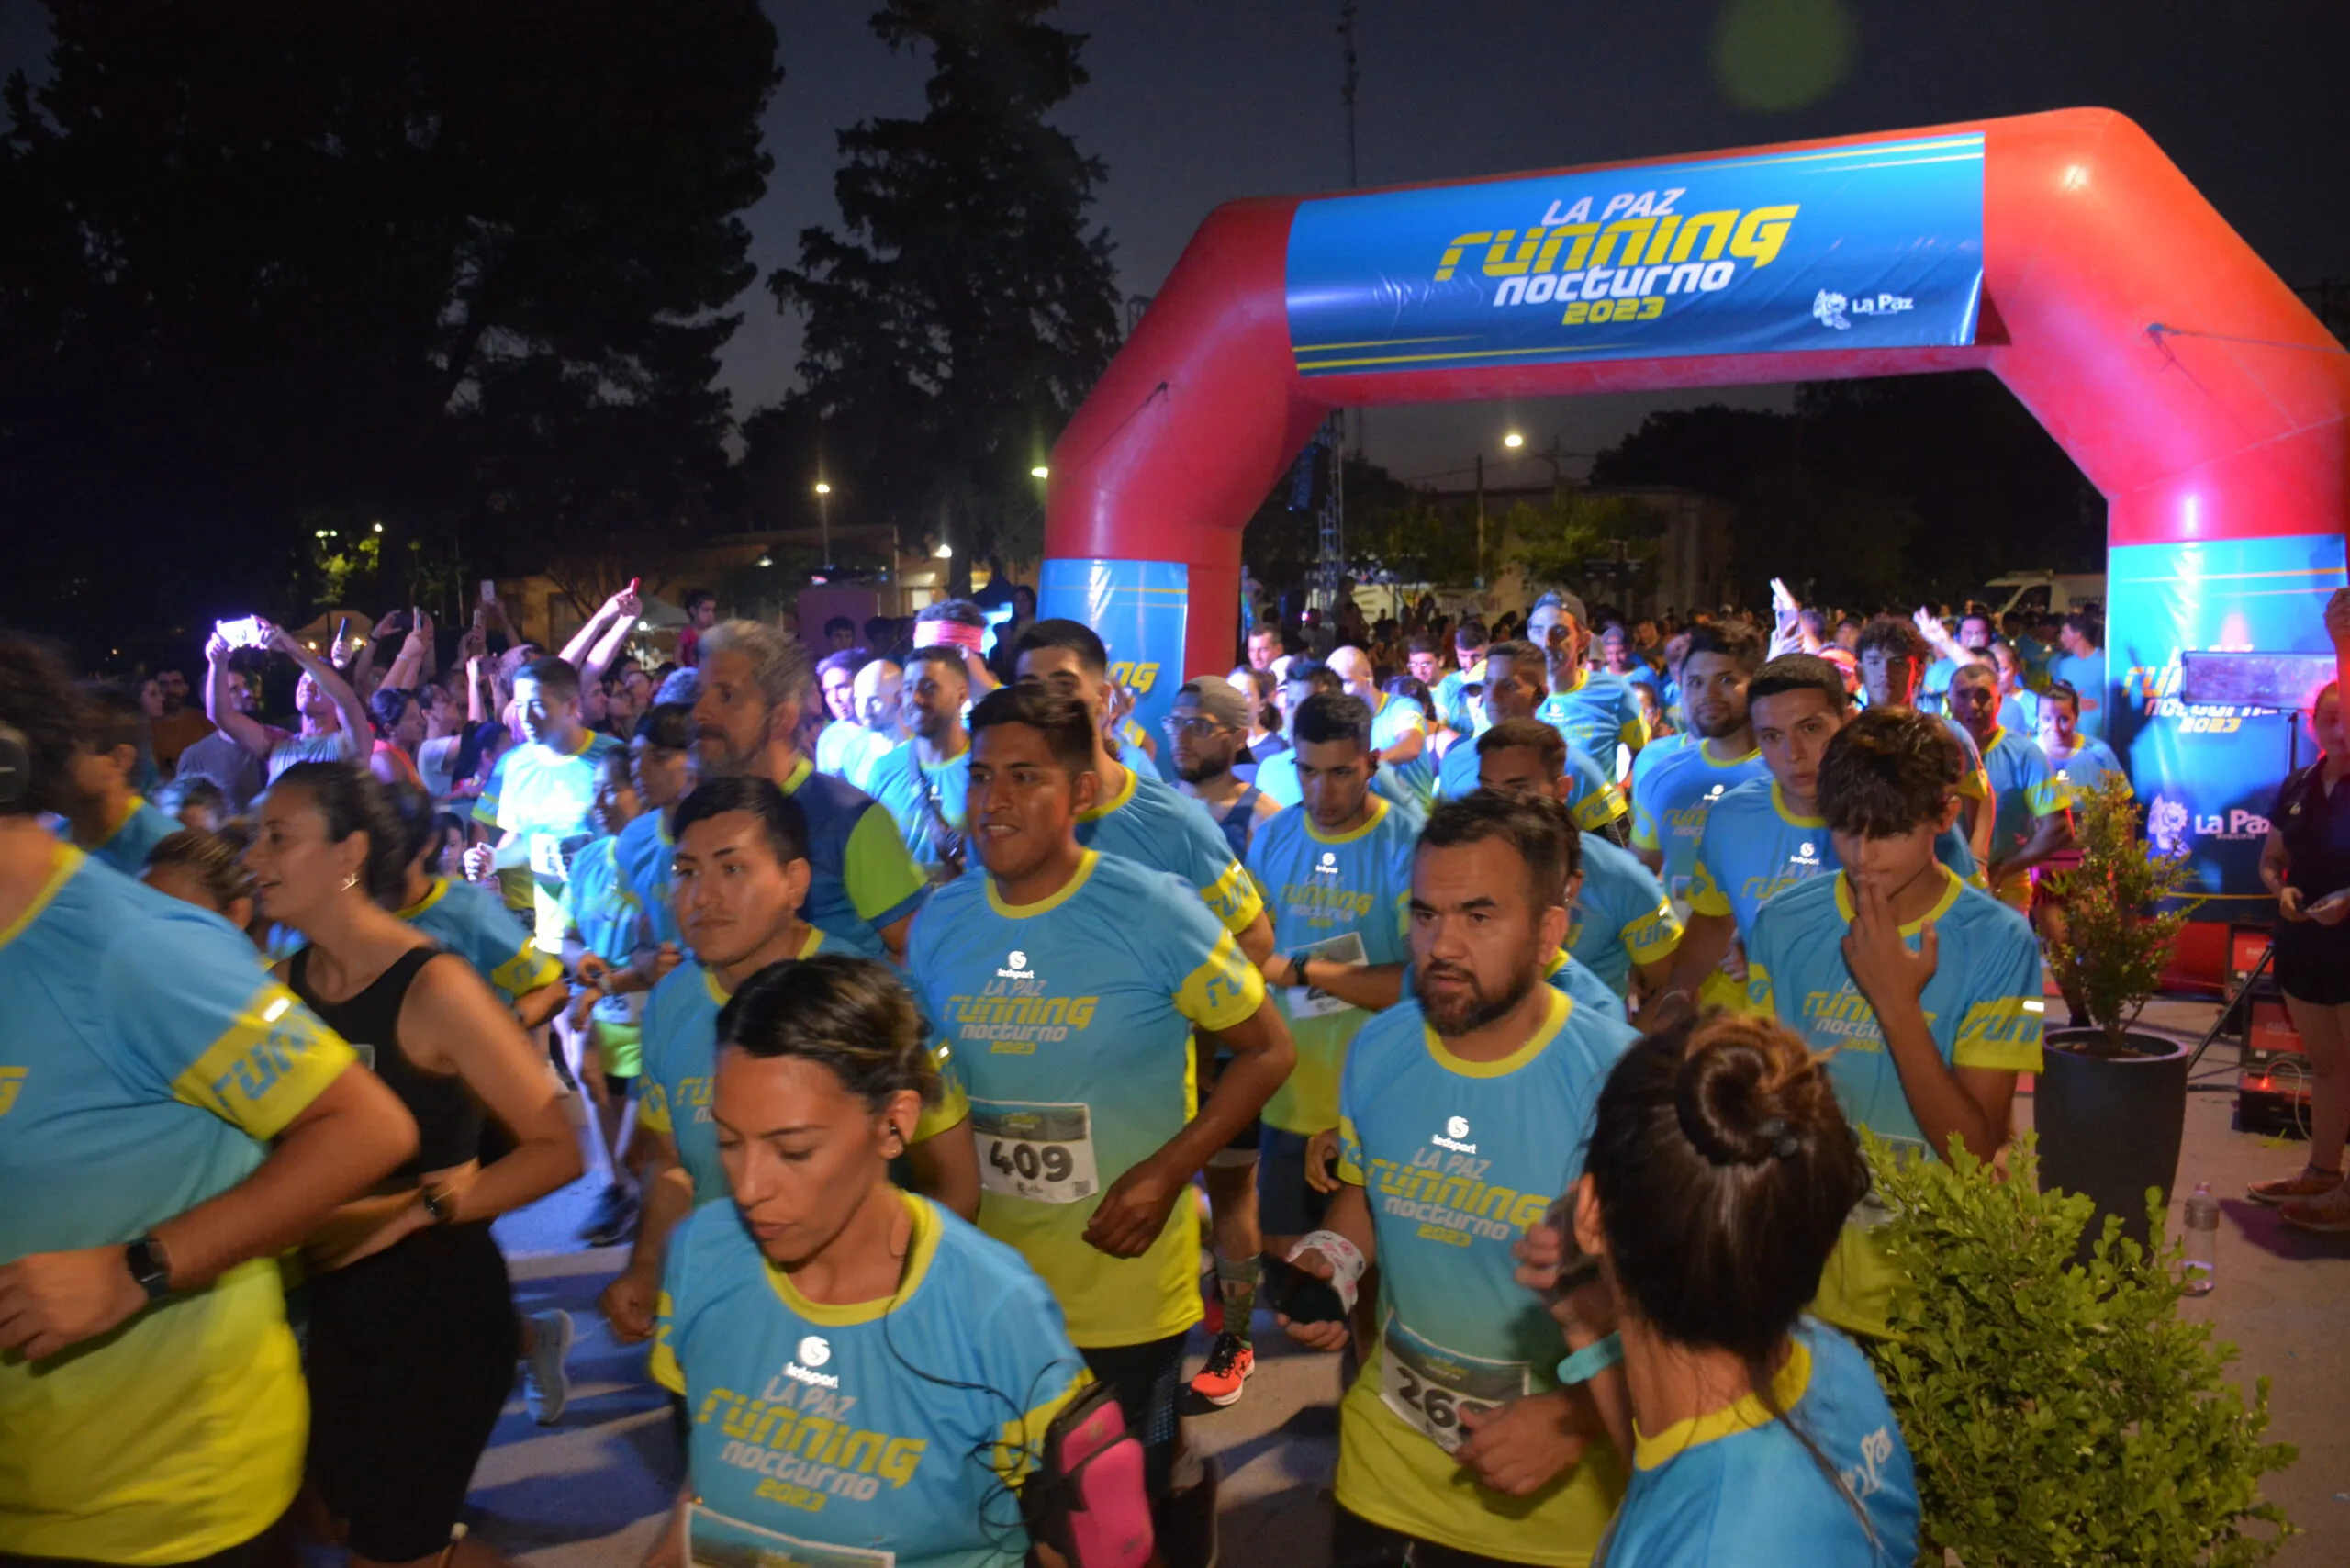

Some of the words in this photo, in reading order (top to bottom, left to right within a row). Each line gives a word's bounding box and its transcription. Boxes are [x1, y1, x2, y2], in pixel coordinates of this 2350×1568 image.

[1541, 196, 1594, 227] LA
[1601, 187, 1687, 220] PAZ
[1493, 261, 1736, 307] nocturno
[1561, 296, 1666, 326] 2023
[1852, 297, 1874, 313] La
[1877, 293, 1915, 311] Paz
[2178, 717, 2242, 733] 2023
[2195, 814, 2224, 834] La
[983, 979, 1007, 997] LA
[1009, 980, 1048, 997] PAZ
[960, 1023, 1068, 1042] nocturno
[990, 1040, 1037, 1055] 2023
[990, 1140, 1074, 1182] 409
[1411, 1147, 1444, 1170] LA
[1444, 1154, 1492, 1181] PAZ
[1383, 1196, 1511, 1240] nocturno
[1416, 1222, 1473, 1248] 2023
[762, 1375, 799, 1406] LA
[799, 1387, 858, 1422] PAZ
[721, 1439, 881, 1502] nocturno
[755, 1478, 828, 1513] 2023
